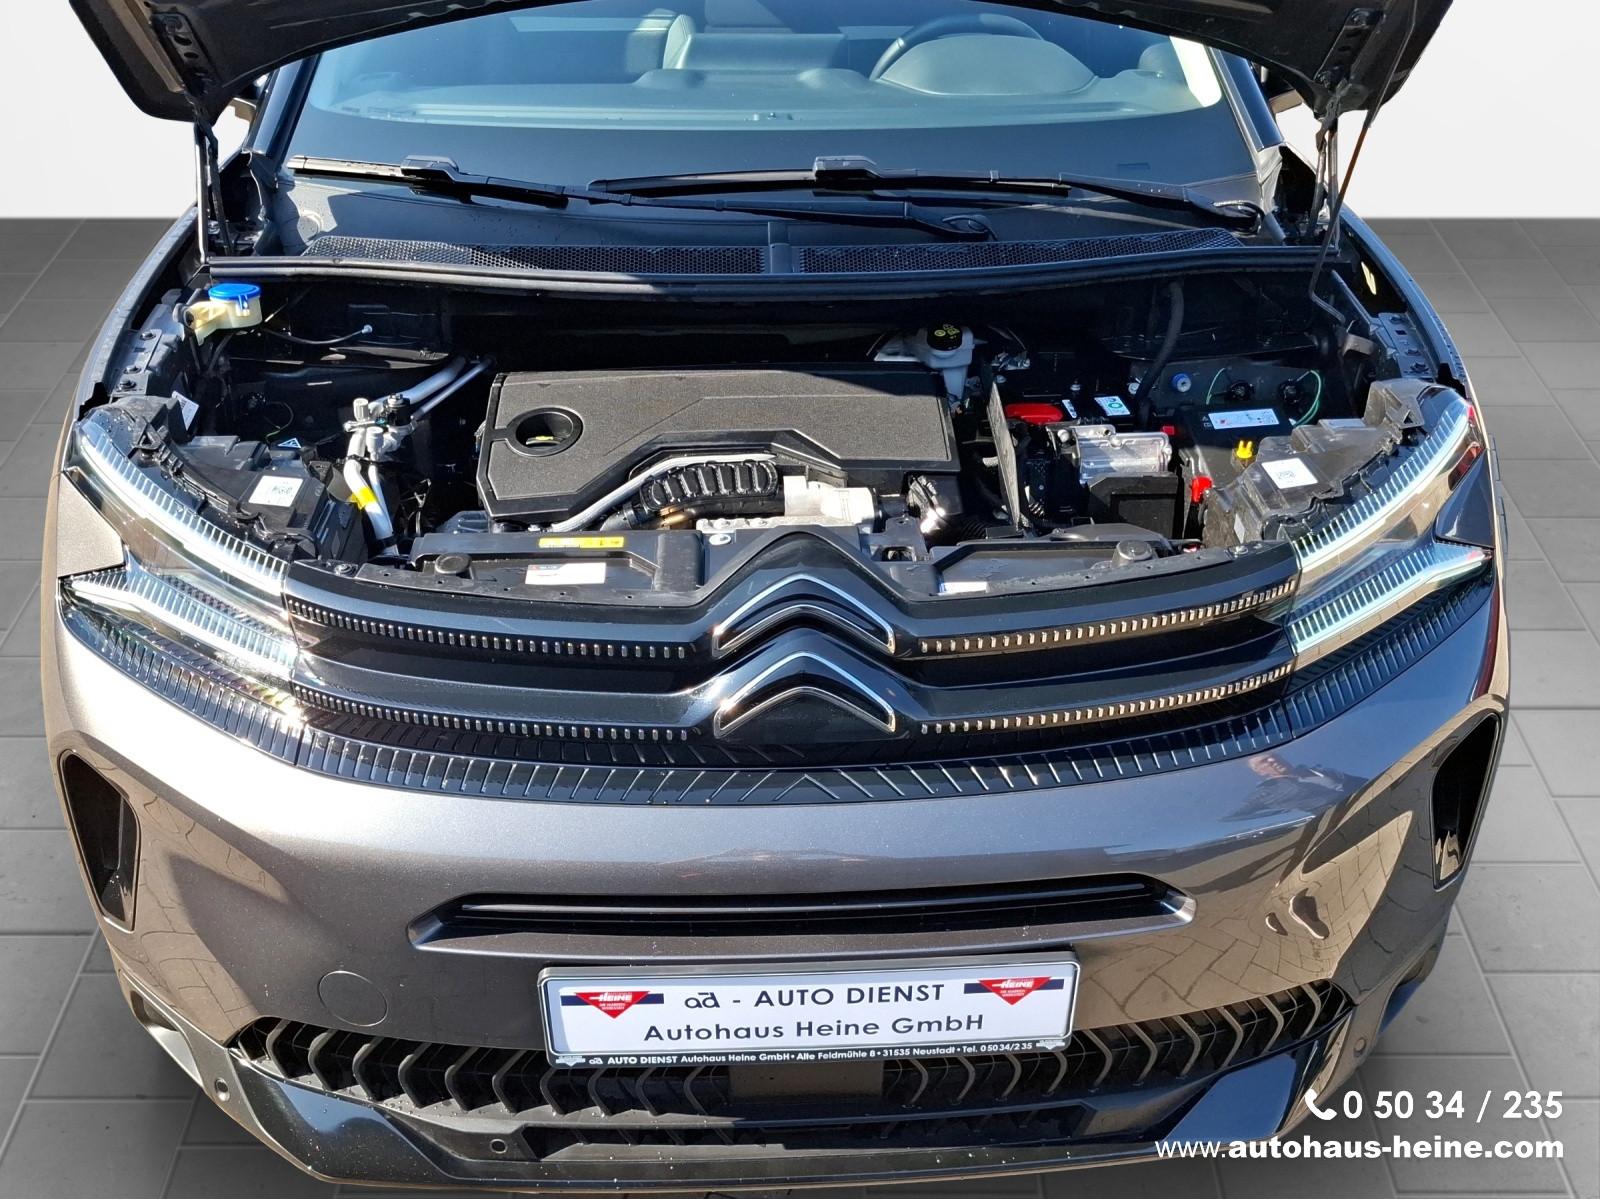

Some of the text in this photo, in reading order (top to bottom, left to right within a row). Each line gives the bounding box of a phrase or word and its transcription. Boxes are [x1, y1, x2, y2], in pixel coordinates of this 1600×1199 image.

[753, 988, 834, 1007] AUTO
[847, 983, 945, 1005] DIENST
[643, 1014, 983, 1042] Autohaus Heine GmbH
[607, 1056, 638, 1065] AUTO
[640, 1055, 678, 1064] DIENST
[681, 1054, 726, 1063] Autohaus
[728, 1053, 756, 1062] Heine
[818, 1050, 868, 1060] Feldmühle
[912, 1046, 956, 1056] Neustadt
[962, 1044, 978, 1053] Tel.
